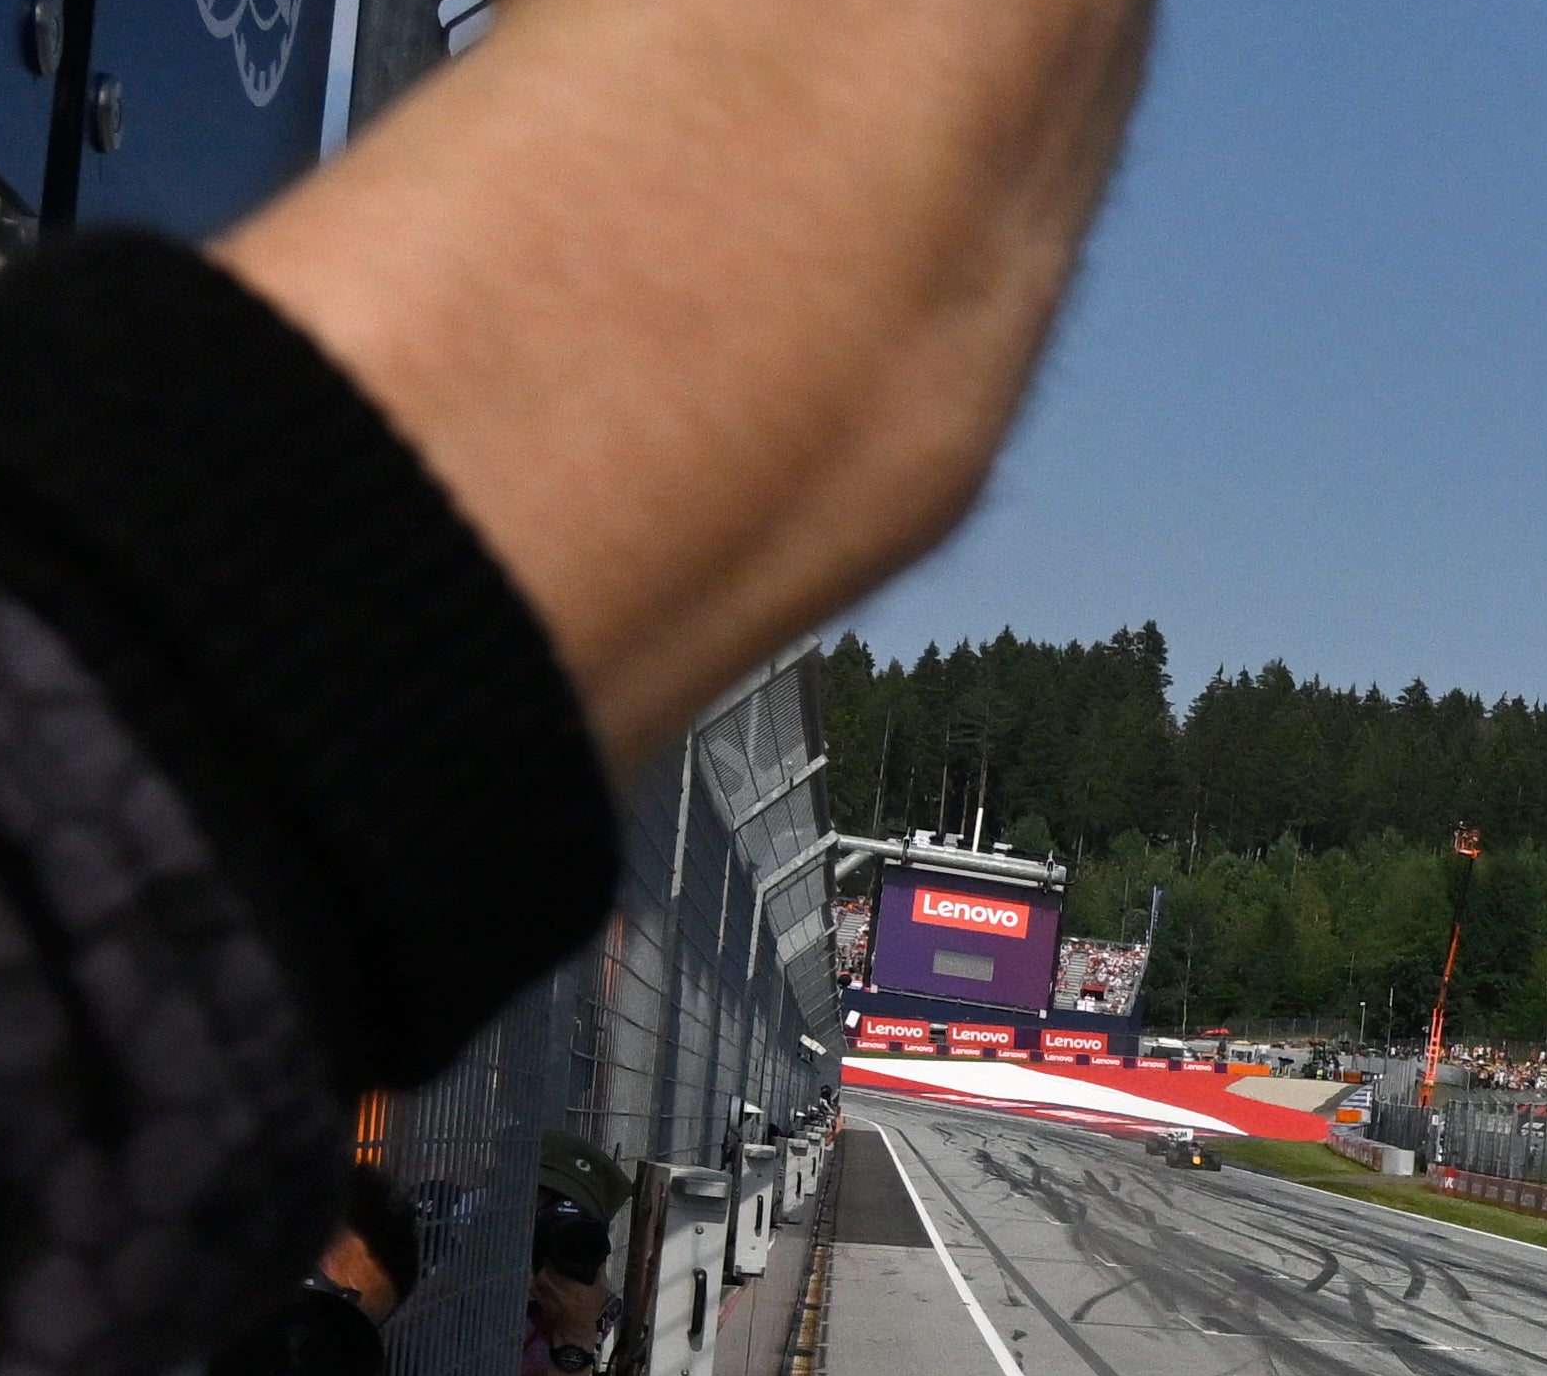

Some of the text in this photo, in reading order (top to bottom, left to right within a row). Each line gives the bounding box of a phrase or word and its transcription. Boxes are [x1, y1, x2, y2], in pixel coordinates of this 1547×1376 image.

[923, 894, 1018, 927] Lenovo
[868, 1022, 923, 1037] Lenovo
[953, 1028, 1008, 1043] Lenovo
[856, 1041, 887, 1050] Lenovo
[1046, 1034, 1101, 1050] Lenovo
[904, 1044, 934, 1053] Lenovo
[951, 1048, 981, 1056] Lenovo
[998, 1051, 1028, 1059] Lenovo
[1043, 1054, 1074, 1063] Lenovo
[1091, 1057, 1121, 1066] Lenovo
[1137, 1060, 1167, 1069] Lenovo
[1183, 1061, 1213, 1072] Lenovo
